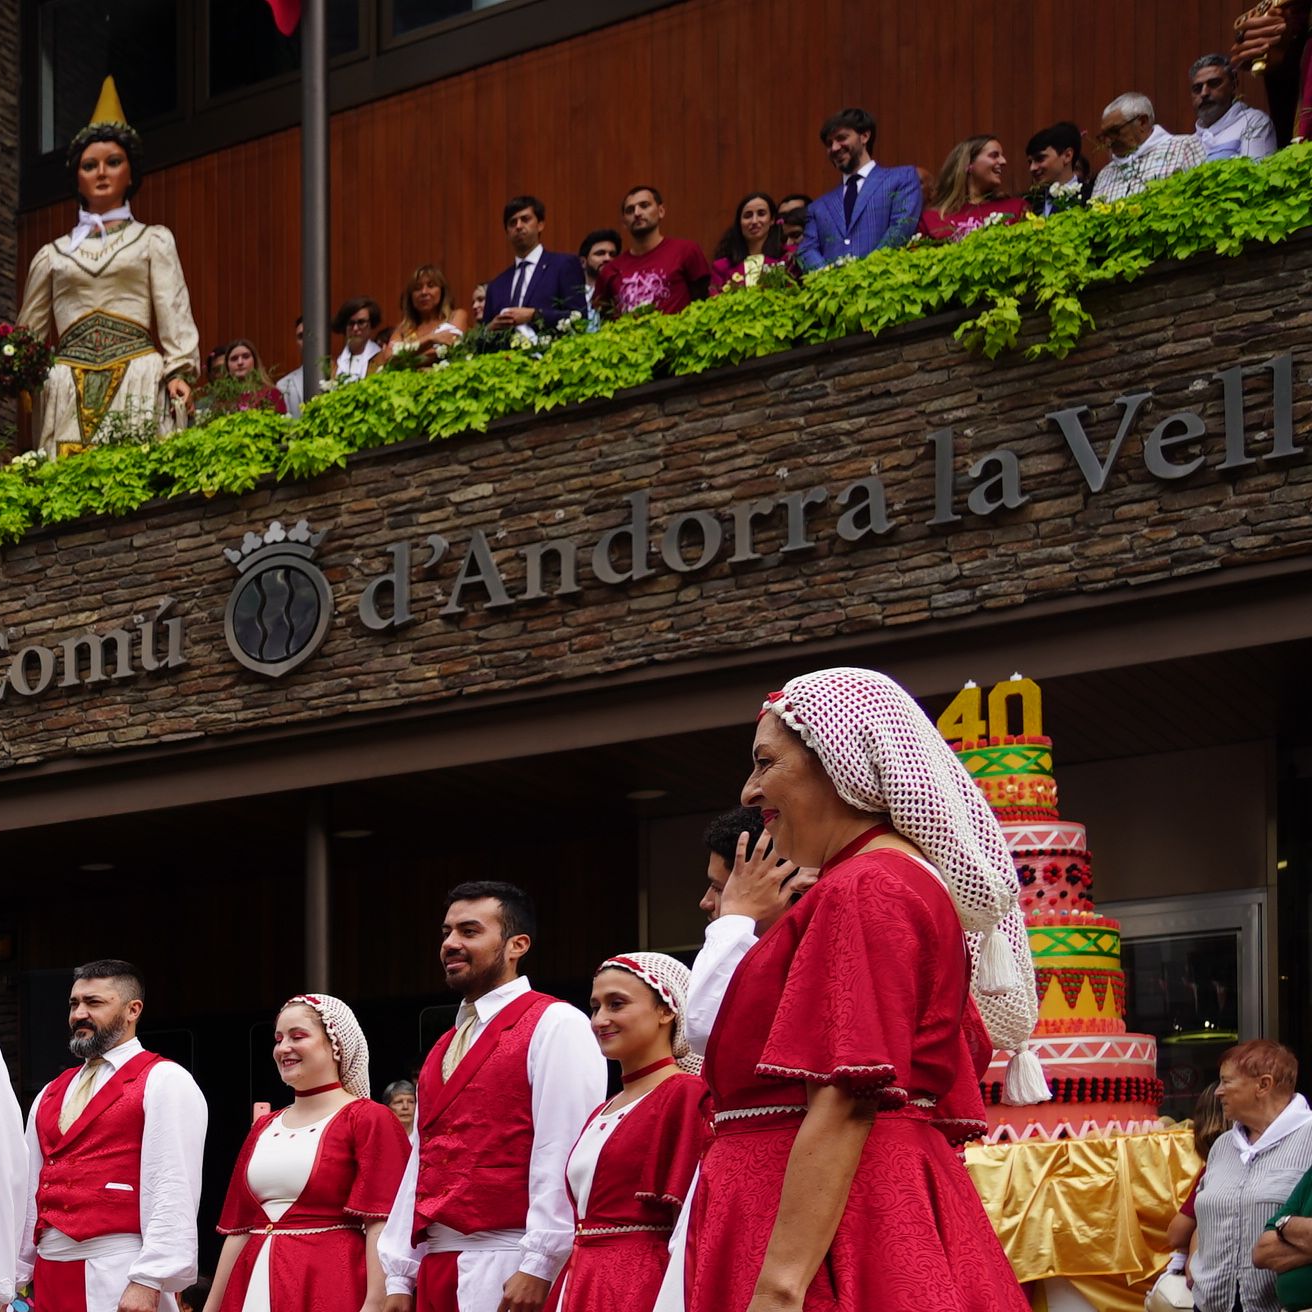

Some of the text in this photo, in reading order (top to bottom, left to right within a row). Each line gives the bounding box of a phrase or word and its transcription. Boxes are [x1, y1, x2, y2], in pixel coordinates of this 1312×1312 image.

[358, 476, 897, 630] d'Andorra
[926, 426, 1031, 526] la
[1045, 352, 1305, 494] Vell
[936, 677, 1043, 750] 40
